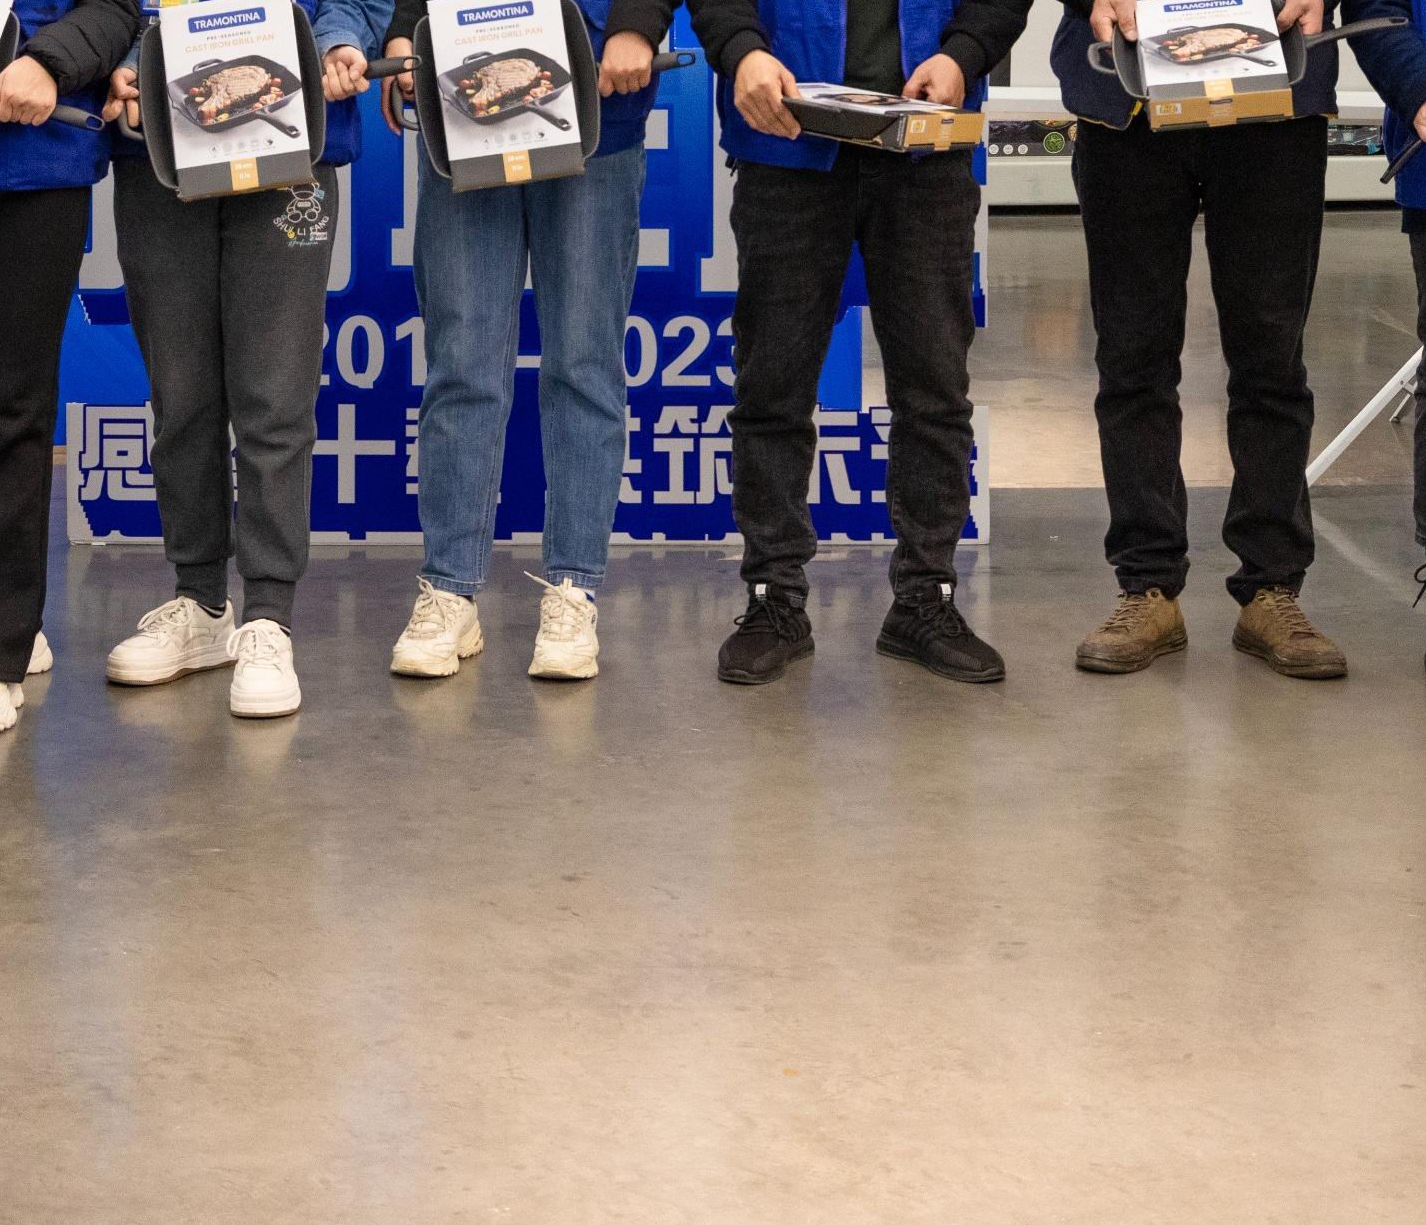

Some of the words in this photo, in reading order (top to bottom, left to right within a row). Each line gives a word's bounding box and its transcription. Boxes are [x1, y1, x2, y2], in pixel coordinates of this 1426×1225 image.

[463, 5, 529, 22] TRAMONTINA
[1168, 0, 1239, 12] TRAMONTINA
[194, 11, 260, 29] TRAMONTINA
[297, 227, 306, 236] LI
[309, 215, 330, 234] FANG
